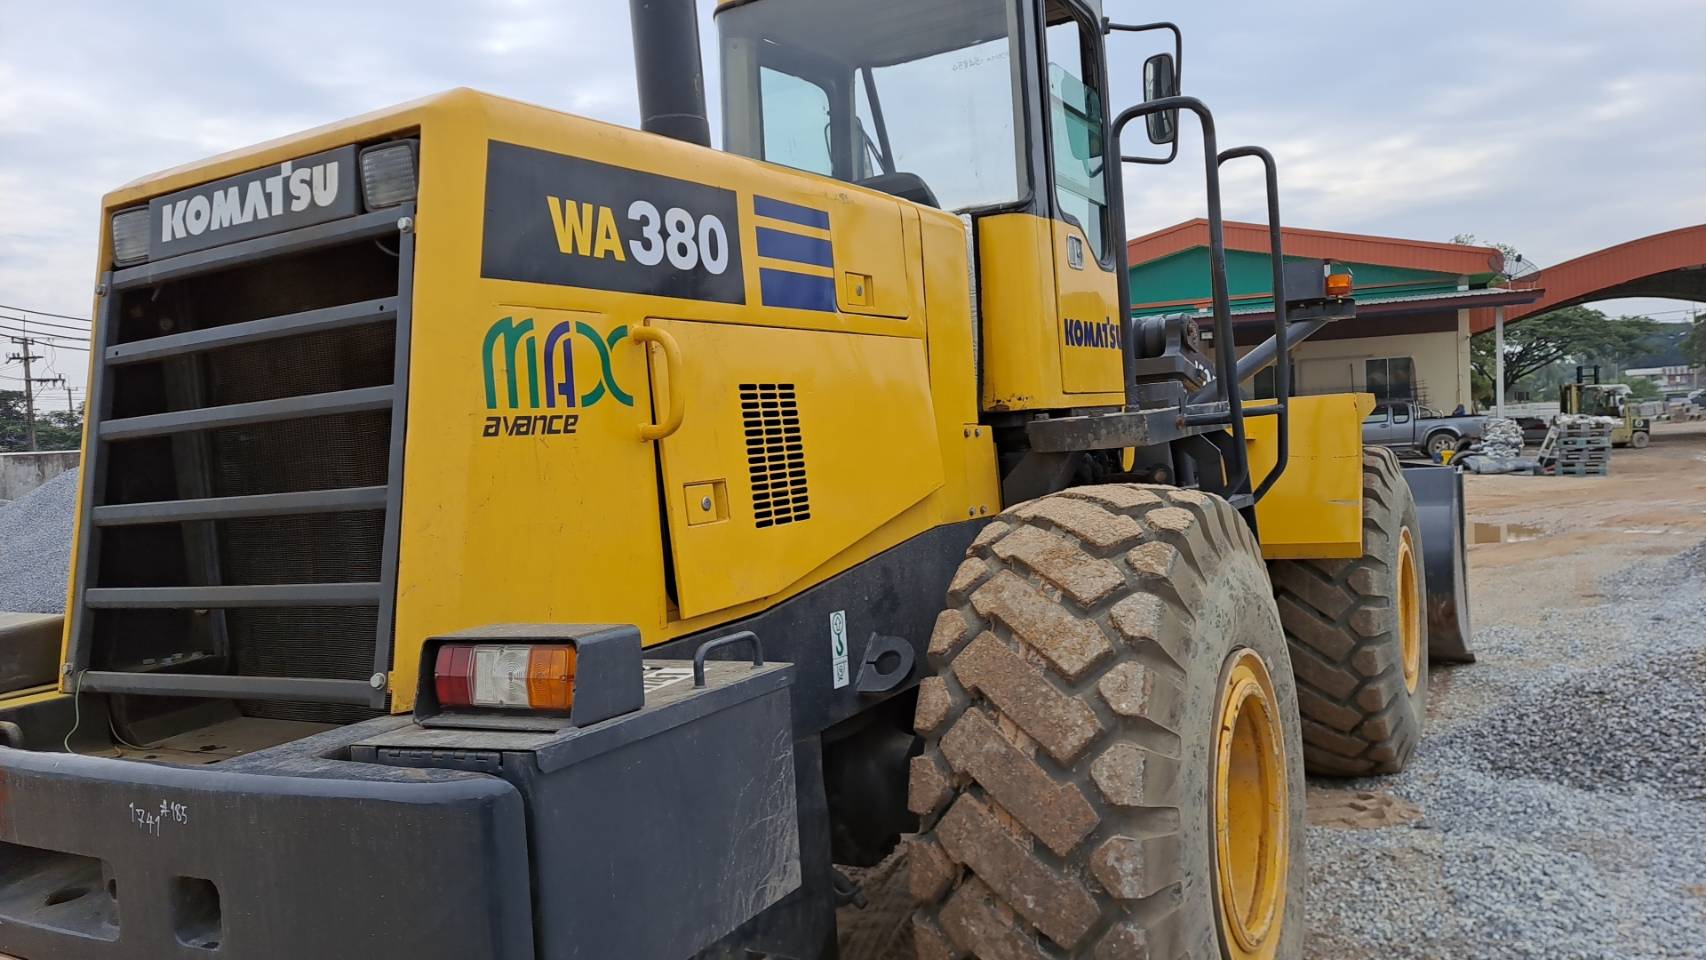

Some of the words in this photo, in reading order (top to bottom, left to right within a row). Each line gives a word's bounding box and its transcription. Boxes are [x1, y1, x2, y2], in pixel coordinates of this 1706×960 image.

[162, 161, 339, 242] KOMATSU
[482, 316, 634, 409] MAX
[482, 414, 579, 437] avance
